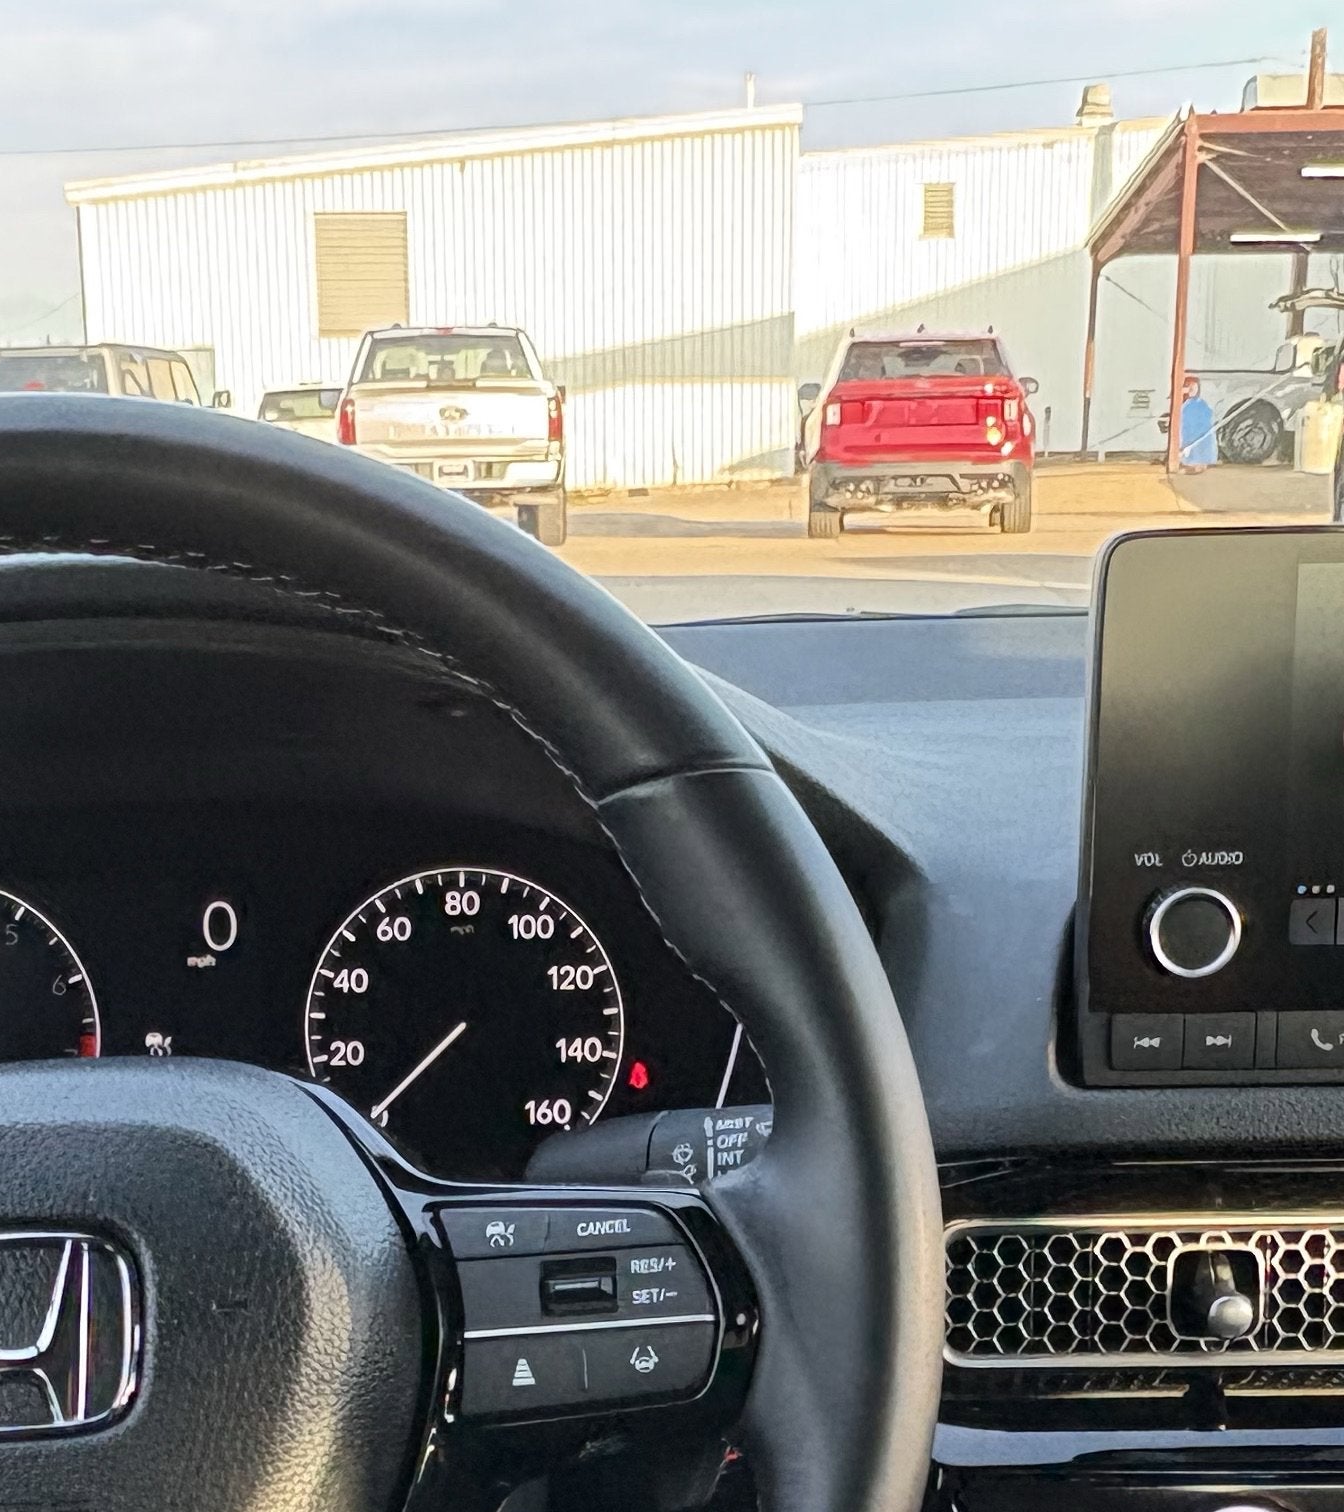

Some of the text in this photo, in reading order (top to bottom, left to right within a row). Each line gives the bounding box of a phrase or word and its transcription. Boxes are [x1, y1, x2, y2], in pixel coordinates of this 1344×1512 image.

[1134, 851, 1163, 867] VOL
[1198, 851, 1244, 866] AUDIO
[444, 891, 480, 916] 80
[5, 926, 19, 945] 5
[203, 901, 237, 950] 0
[376, 917, 412, 941] 60
[508, 915, 555, 940] 100
[52, 976, 66, 995] 6
[332, 968, 369, 993] 40
[547, 966, 594, 991] 120
[329, 1041, 365, 1066] 20
[555, 1037, 602, 1062] 140
[524, 1100, 572, 1125] 160
[716, 1132, 749, 1149] OFF
[717, 1150, 745, 1166] INT
[577, 1218, 631, 1237] CANCEL
